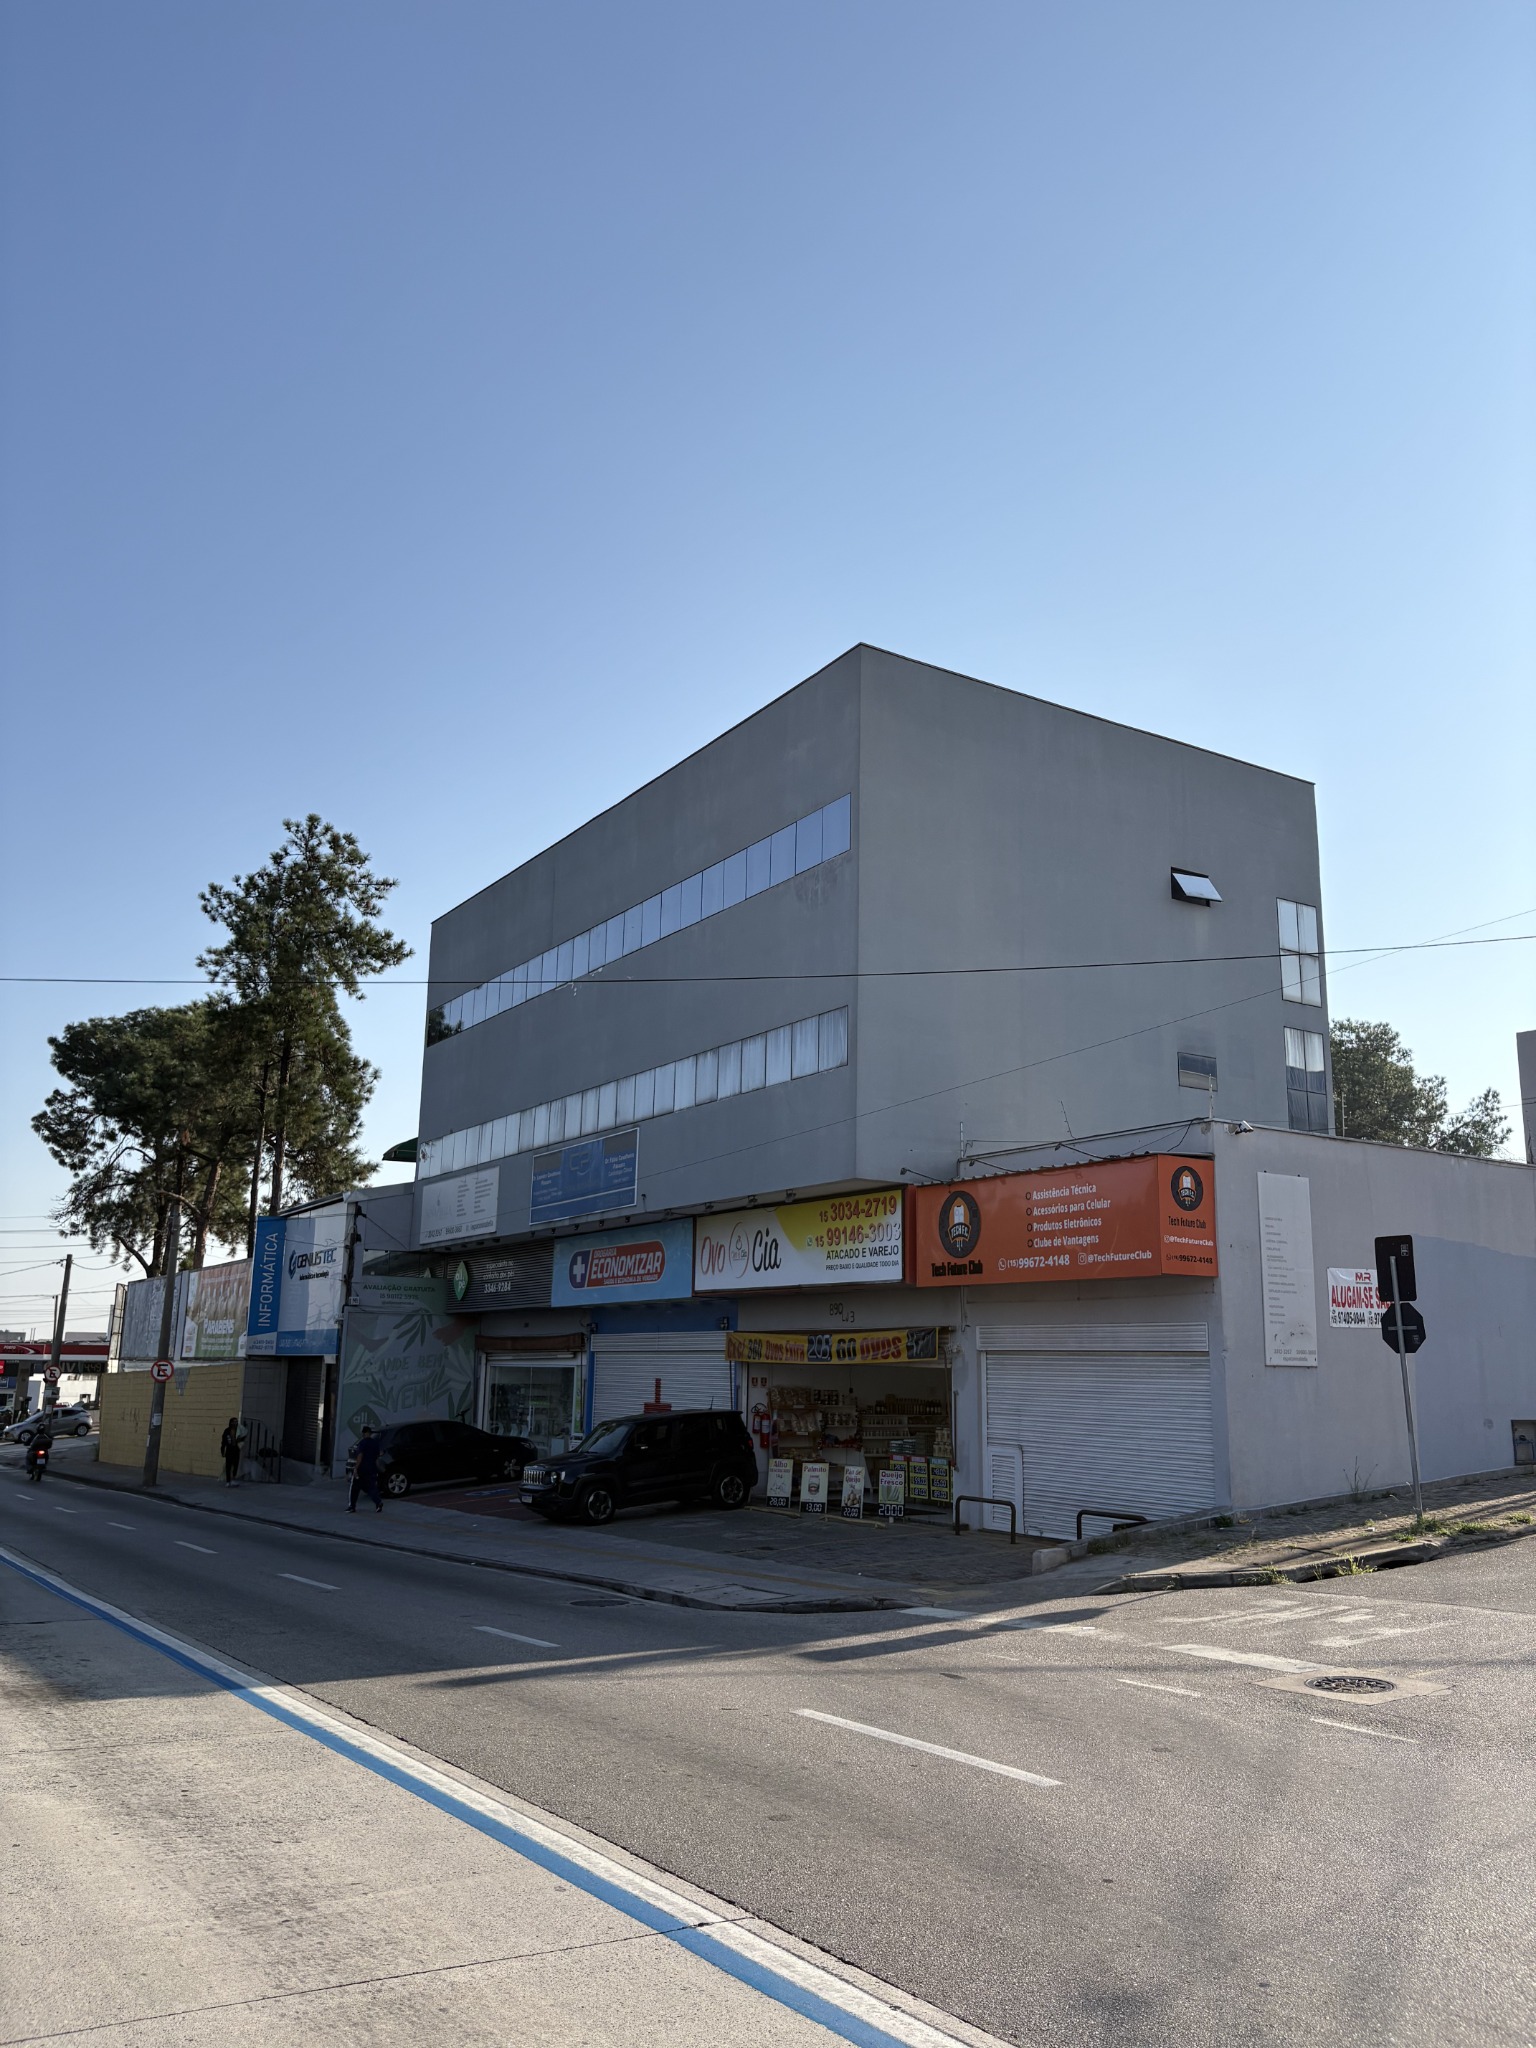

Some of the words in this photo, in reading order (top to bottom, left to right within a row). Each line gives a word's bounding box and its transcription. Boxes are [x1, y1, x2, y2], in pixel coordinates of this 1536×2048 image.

[1032, 1187, 1070, 1200] Assistência
[1071, 1183, 1097, 1195] Técnica
[819, 1210, 829, 1222] 15
[830, 1195, 897, 1221] 3034-2719
[1032, 1204, 1068, 1216] Acessórios
[1069, 1203, 1085, 1213] para
[1086, 1198, 1111, 1210] Celular
[1033, 1221, 1063, 1232] Produtos
[1064, 1217, 1102, 1229] Eletrônicos
[815, 1235, 824, 1247] 15
[826, 1223, 901, 1247] 99146-3003
[1033, 1237, 1053, 1248] Clube
[1053, 1238, 1062, 1247] de
[1063, 1234, 1099, 1247] Vantagens
[700, 1236, 725, 1275] Ovo
[752, 1228, 781, 1272] Cia
[826, 1249, 860, 1260] ATACADO
[861, 1248, 867, 1258] E
[868, 1245, 899, 1257] VAREJO
[1087, 1250, 1152, 1263] @TechFutureClub
[590, 1251, 663, 1280] ECONOMIZAR
[258, 1233, 278, 1327] INFORMÁTICA
[1355, 1272, 1371, 1281] MR
[363, 1284, 402, 1292] AVALIAÇÃO
[1331, 1285, 1374, 1309] ALUGAM-SE
[829, 1303, 843, 1315] 890
[850, 1311, 855, 1323] 3
[836, 1338, 857, 1361] 60
[859, 1336, 902, 1361] OVOS
[773, 1460, 788, 1470] Alho
[803, 1465, 827, 1473] Palmito
[881, 1471, 903, 1480] Queijo
